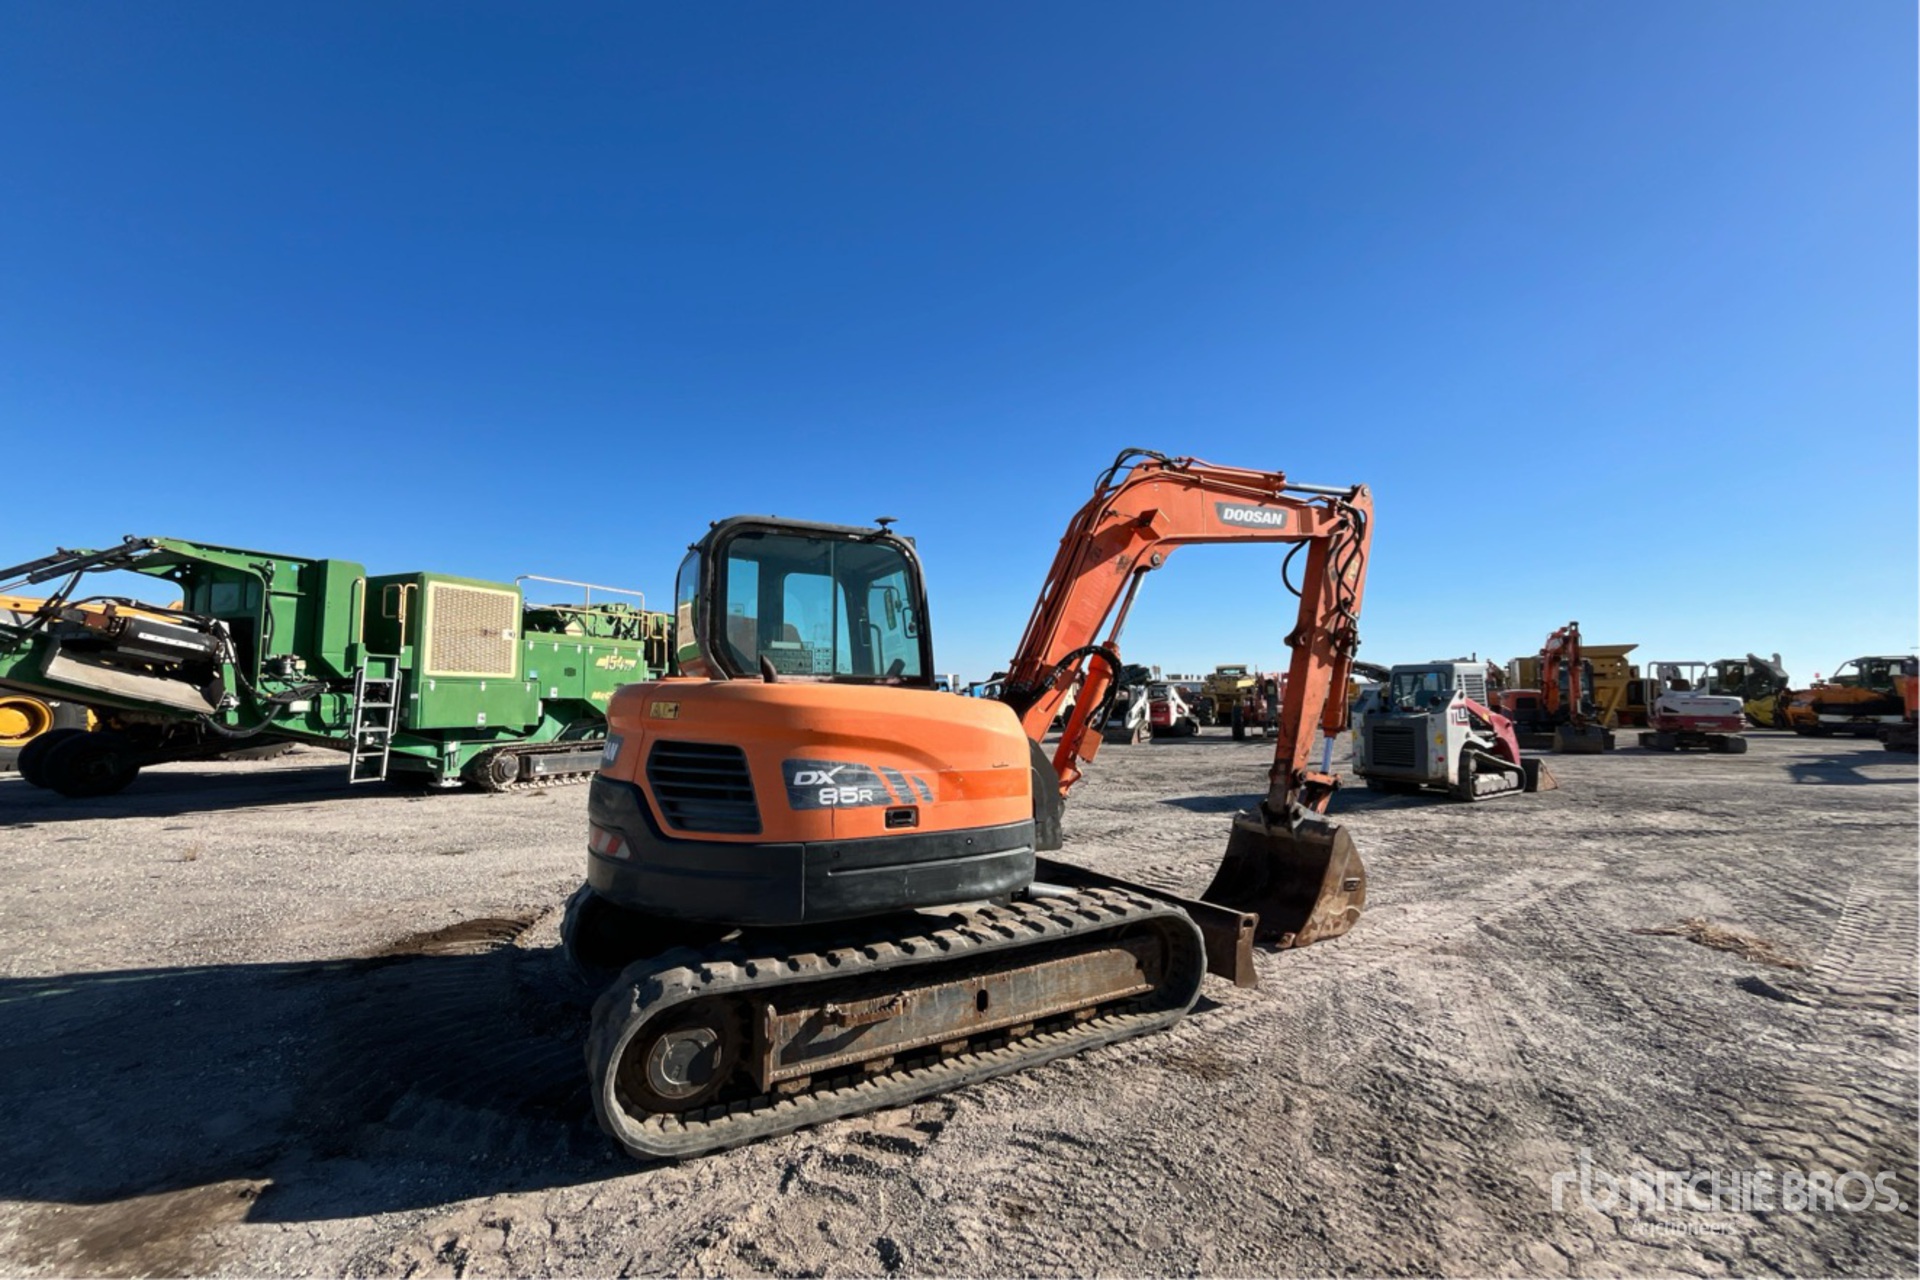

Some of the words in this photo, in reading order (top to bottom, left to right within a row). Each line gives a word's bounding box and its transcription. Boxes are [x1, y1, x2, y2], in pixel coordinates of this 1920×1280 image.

[1223, 507, 1283, 525] DOOSAN
[793, 764, 846, 785] DX
[818, 787, 873, 805] 85R
